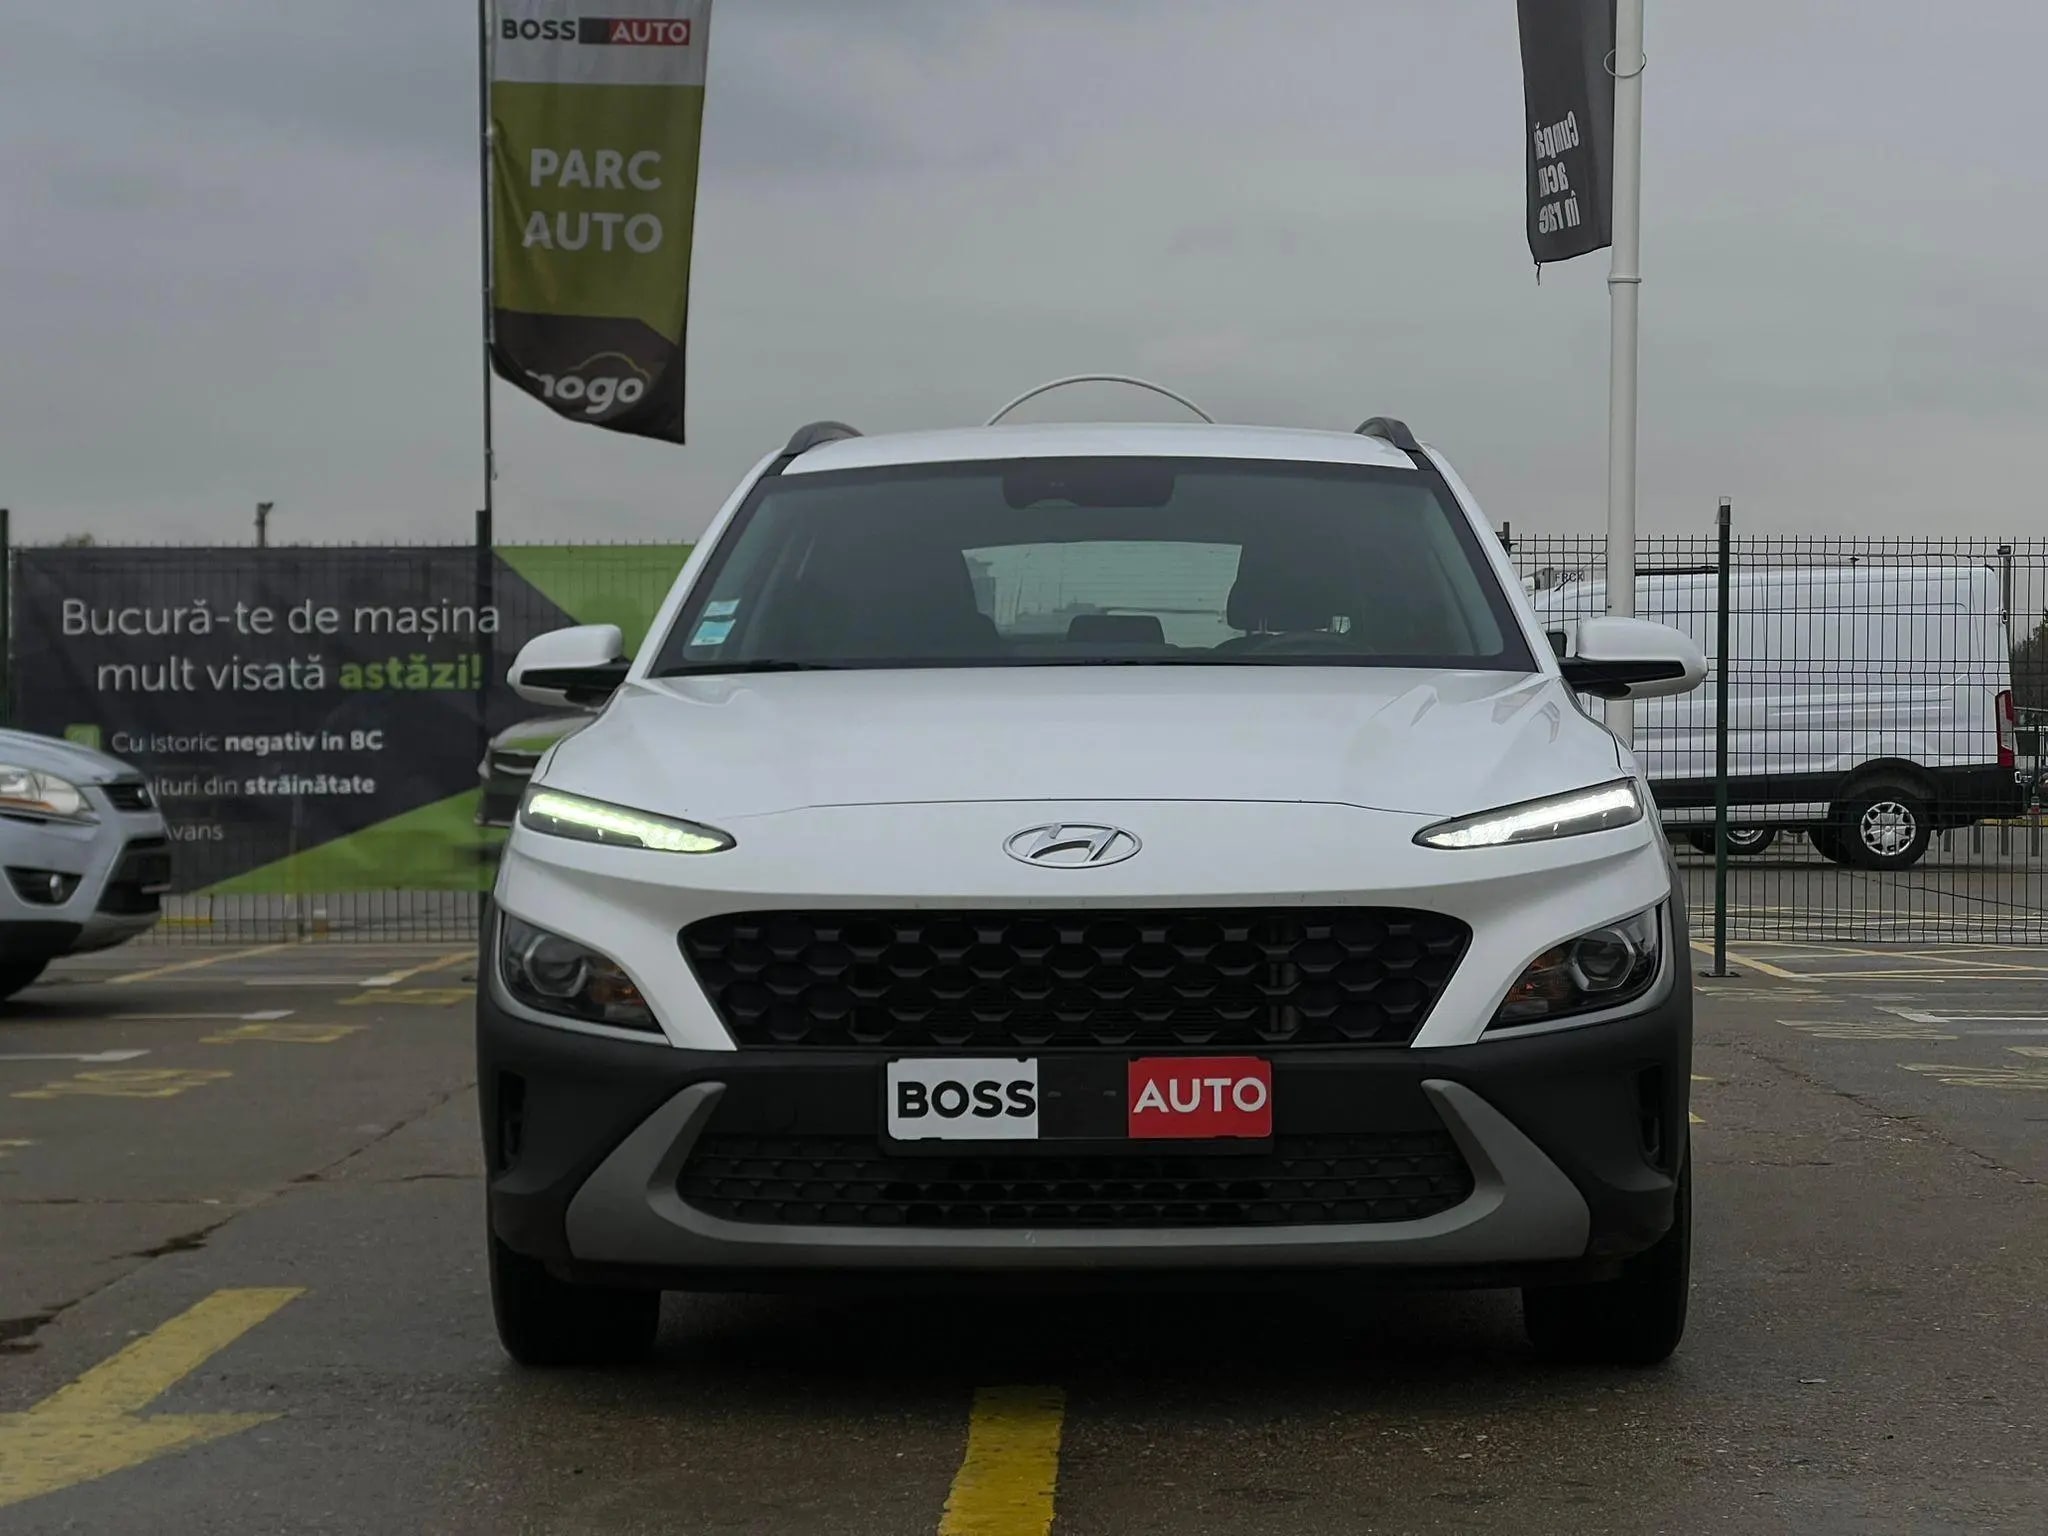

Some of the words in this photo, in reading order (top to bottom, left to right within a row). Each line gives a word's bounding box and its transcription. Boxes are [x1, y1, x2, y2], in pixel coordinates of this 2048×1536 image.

[502, 20, 576, 40] BOSS
[611, 21, 688, 43] AUTO
[529, 148, 663, 190] PARC
[522, 211, 664, 253] AUTO
[62, 598, 275, 635] Bucură-te
[287, 599, 339, 634] de
[354, 597, 500, 643] mașina
[97, 654, 195, 691] mult
[207, 654, 326, 691] visată
[338, 653, 482, 691] astăzi!
[111, 732, 144, 752] Cu
[149, 731, 219, 752] istoric
[225, 730, 317, 755] negativ
[321, 730, 344, 751] in
[350, 730, 384, 751] BC
[147, 776, 198, 796] ituri
[203, 775, 239, 796] din
[244, 774, 376, 796] străinătate
[897, 1080, 1036, 1118] BOSS
[1132, 1077, 1267, 1113] AUTO
